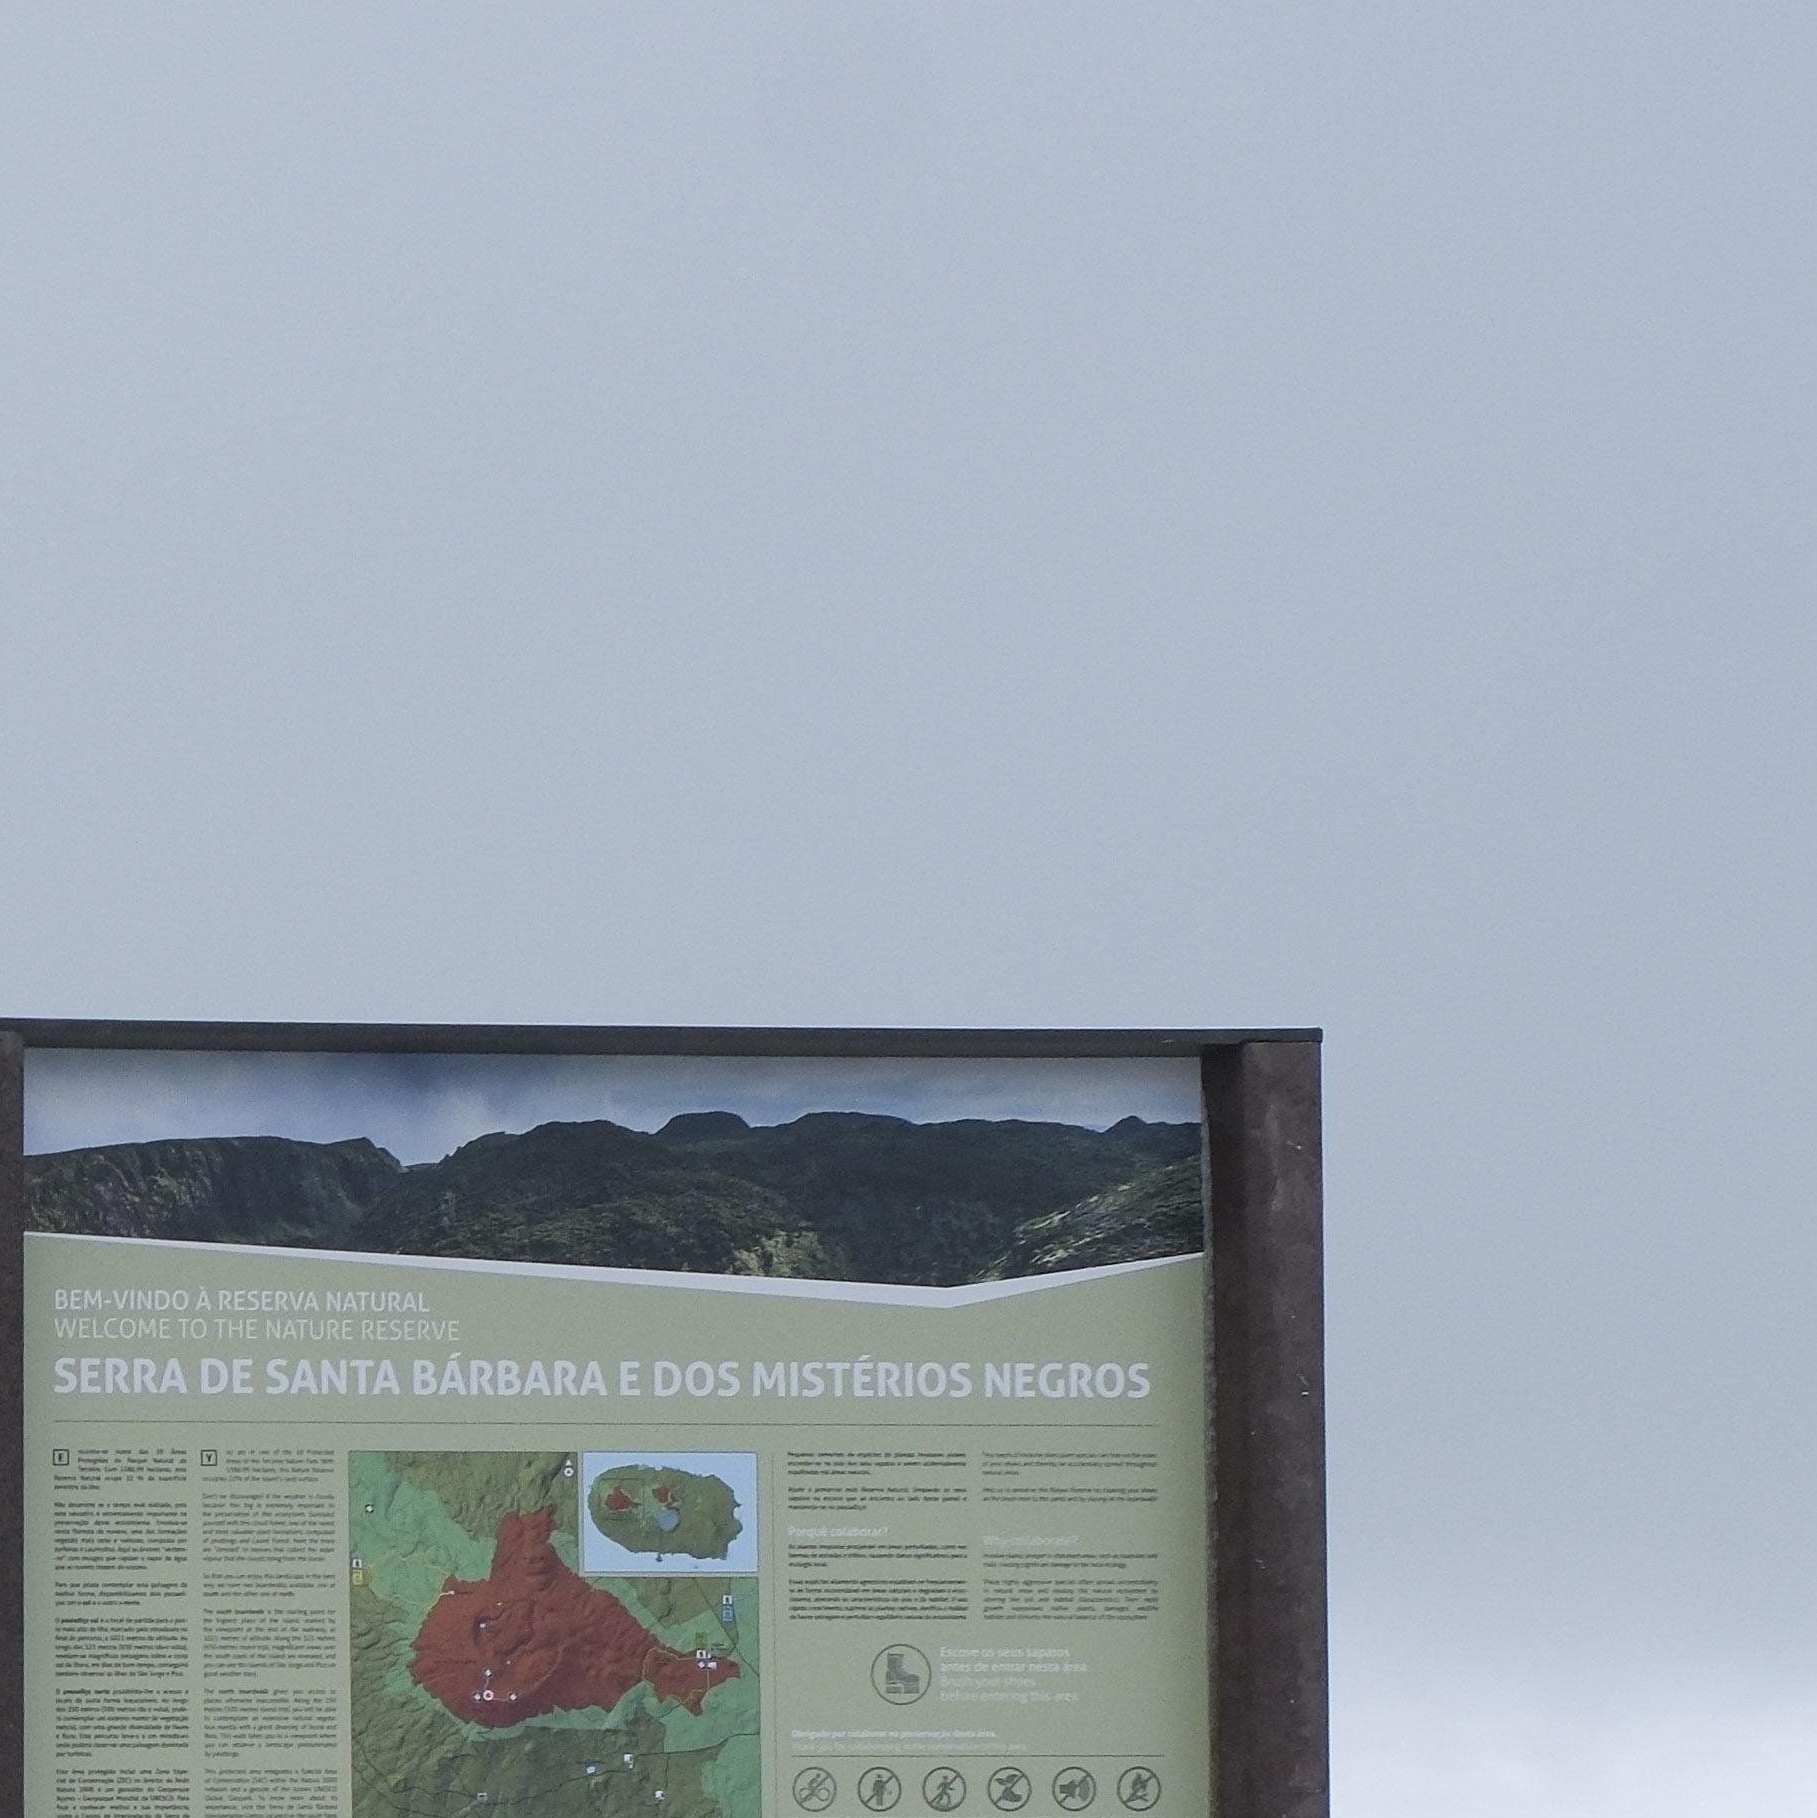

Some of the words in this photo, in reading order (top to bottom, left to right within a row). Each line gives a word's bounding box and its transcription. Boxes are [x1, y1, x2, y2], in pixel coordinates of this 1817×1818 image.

[55, 1288, 189, 1311] BEM-VINDO
[195, 1285, 212, 1311] À
[218, 1289, 320, 1312] RESERVA
[326, 1291, 430, 1313] NATURAL
[54, 1317, 172, 1339] WELCOME
[177, 1318, 207, 1340] TO
[213, 1318, 259, 1340] THE
[266, 1318, 354, 1341] NATURE
[361, 1319, 460, 1341] RESERVE
[54, 1357, 188, 1394] SERRA
[200, 1357, 254, 1395] DE
[265, 1358, 401, 1396] SANTA
[412, 1352, 608, 1399] BÁRBARA
[619, 1360, 641, 1396] E
[653, 1360, 741, 1397] DOS
[752, 1354, 973, 1398] MISTÉRIOS
[984, 1362, 1150, 1399] NEGROS
